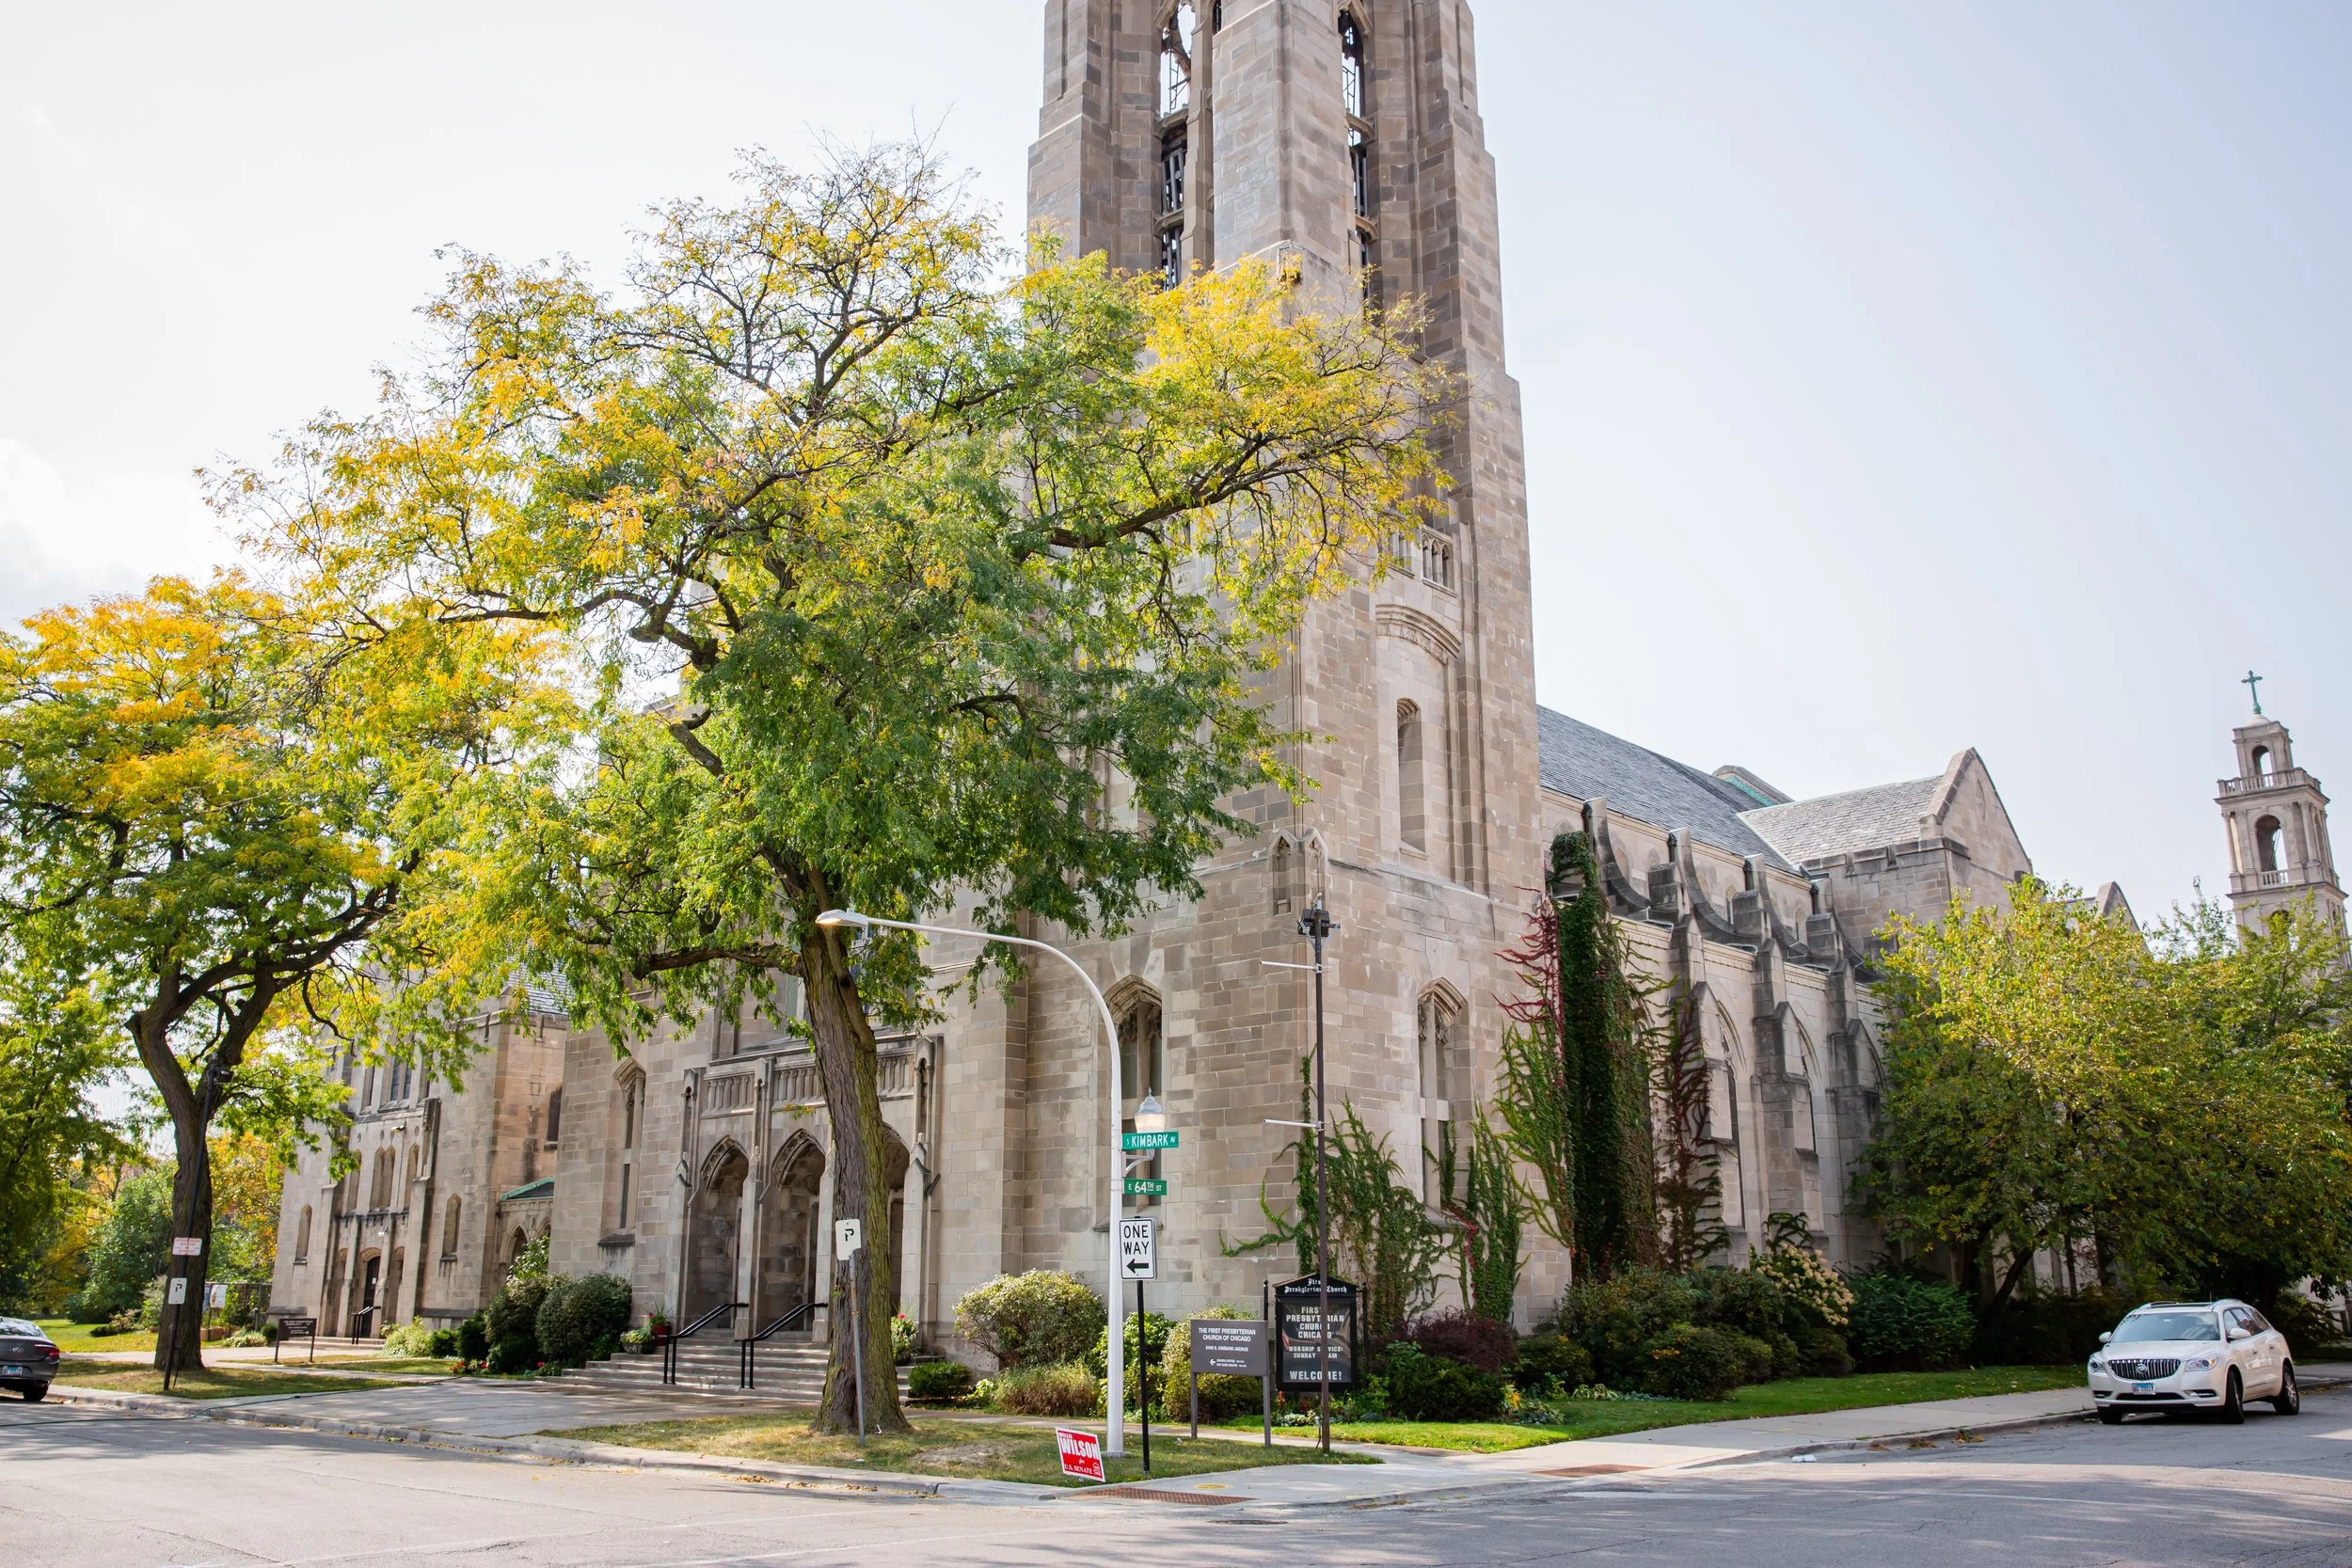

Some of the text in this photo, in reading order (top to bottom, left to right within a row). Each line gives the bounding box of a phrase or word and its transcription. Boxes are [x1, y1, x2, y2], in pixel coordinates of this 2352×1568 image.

[1131, 1134, 1168, 1147] KIMBARK
[1134, 1181, 1154, 1193] 64TH
[1124, 1225, 1149, 1239] ONE
[1124, 1241, 1149, 1255] WAY
[1060, 1437, 1100, 1460] WILSON
[1074, 1465, 1093, 1474] SENATE
